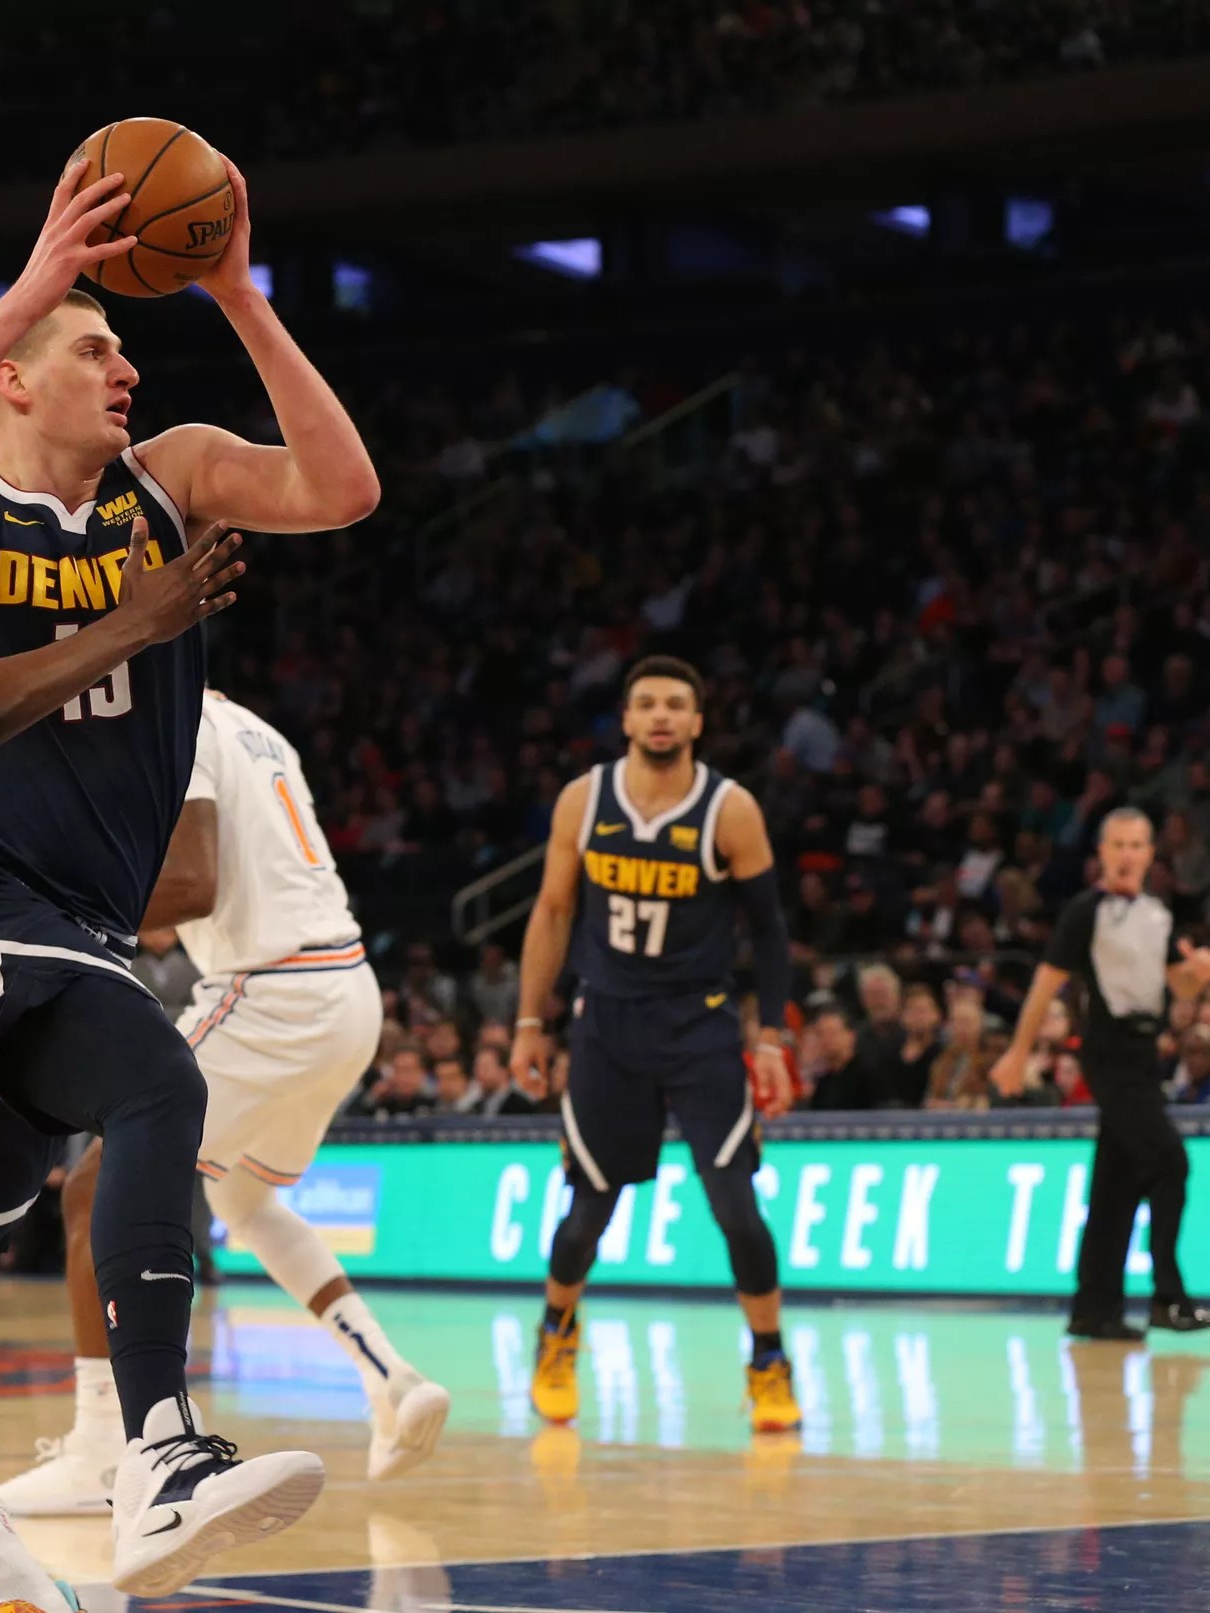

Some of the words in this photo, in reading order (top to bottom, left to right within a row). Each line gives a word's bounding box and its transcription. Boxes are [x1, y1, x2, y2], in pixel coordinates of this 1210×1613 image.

[96, 490, 138, 520] WU
[102, 505, 142, 527] WESTERN
[116, 510, 144, 526] UNION
[607, 893, 670, 958] 27
